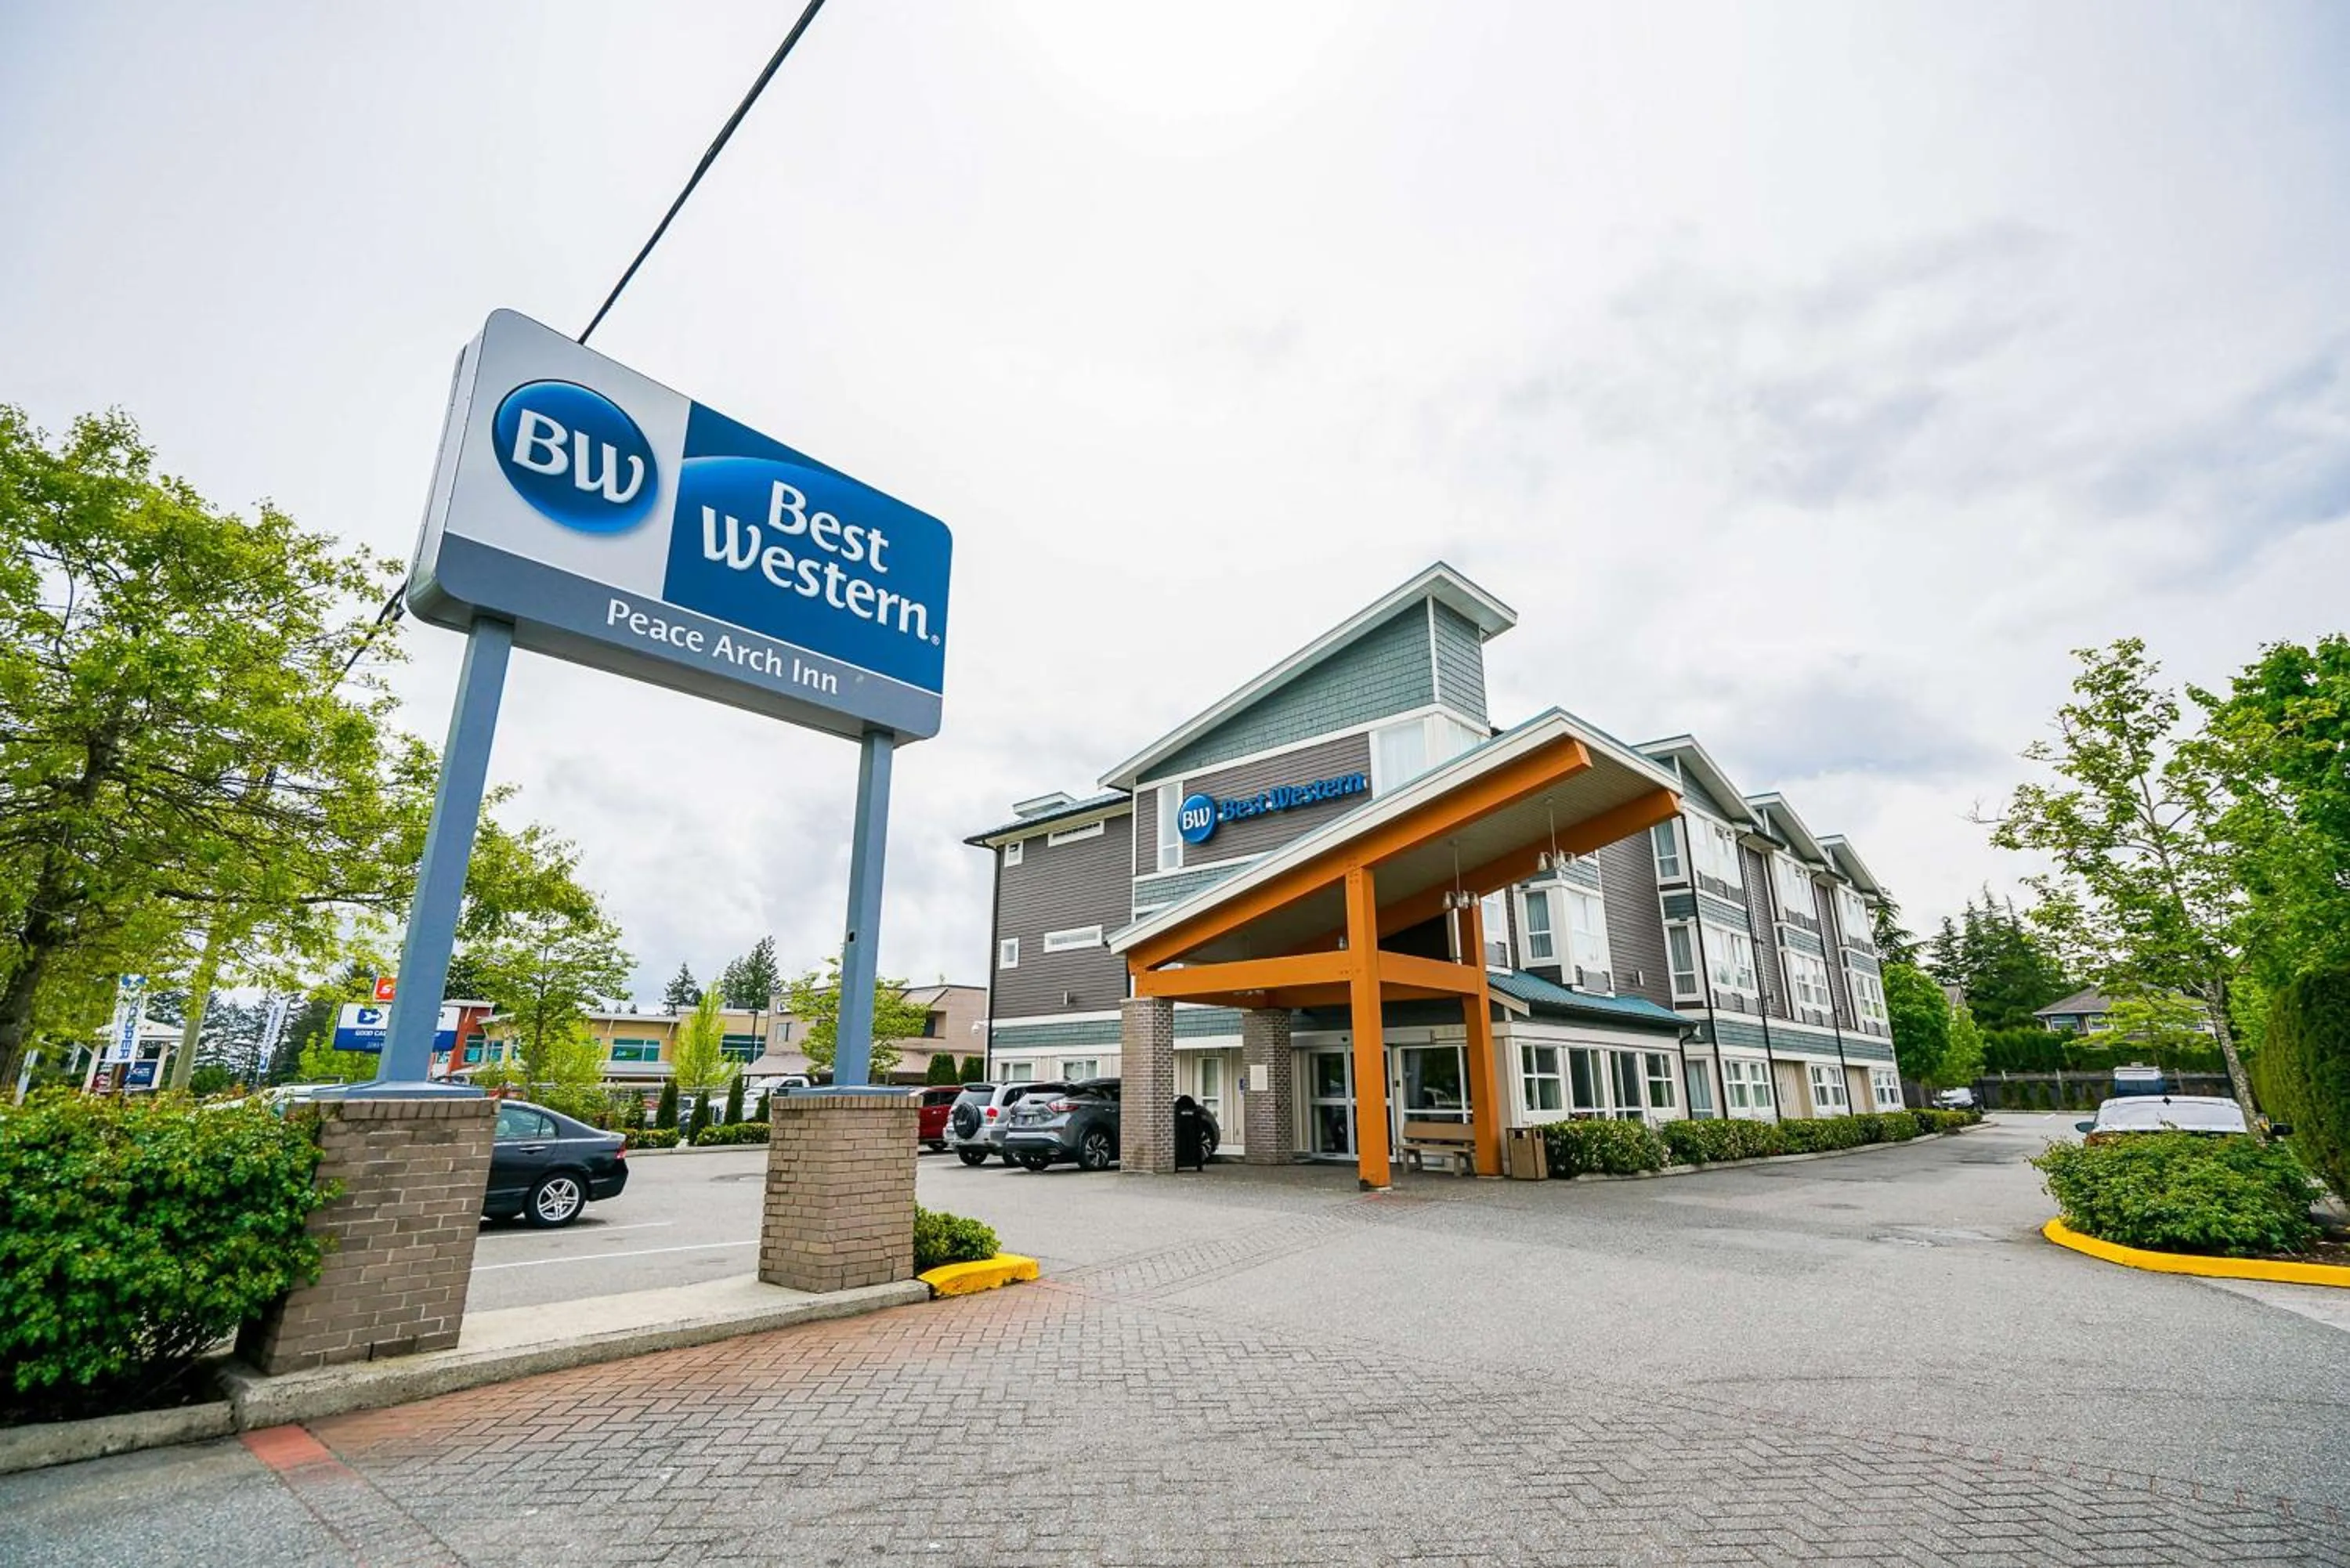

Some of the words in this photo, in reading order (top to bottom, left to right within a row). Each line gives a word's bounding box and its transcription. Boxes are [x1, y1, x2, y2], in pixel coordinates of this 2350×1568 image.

[512, 408, 645, 504] BW
[701, 504, 930, 641] Western
[768, 479, 890, 574] Best
[606, 598, 705, 653] Peace
[711, 634, 783, 678] Arch
[792, 658, 839, 695] Inn
[1181, 806, 1211, 831] BW
[1220, 793, 1267, 822] Best
[1269, 771, 1367, 811] Western
